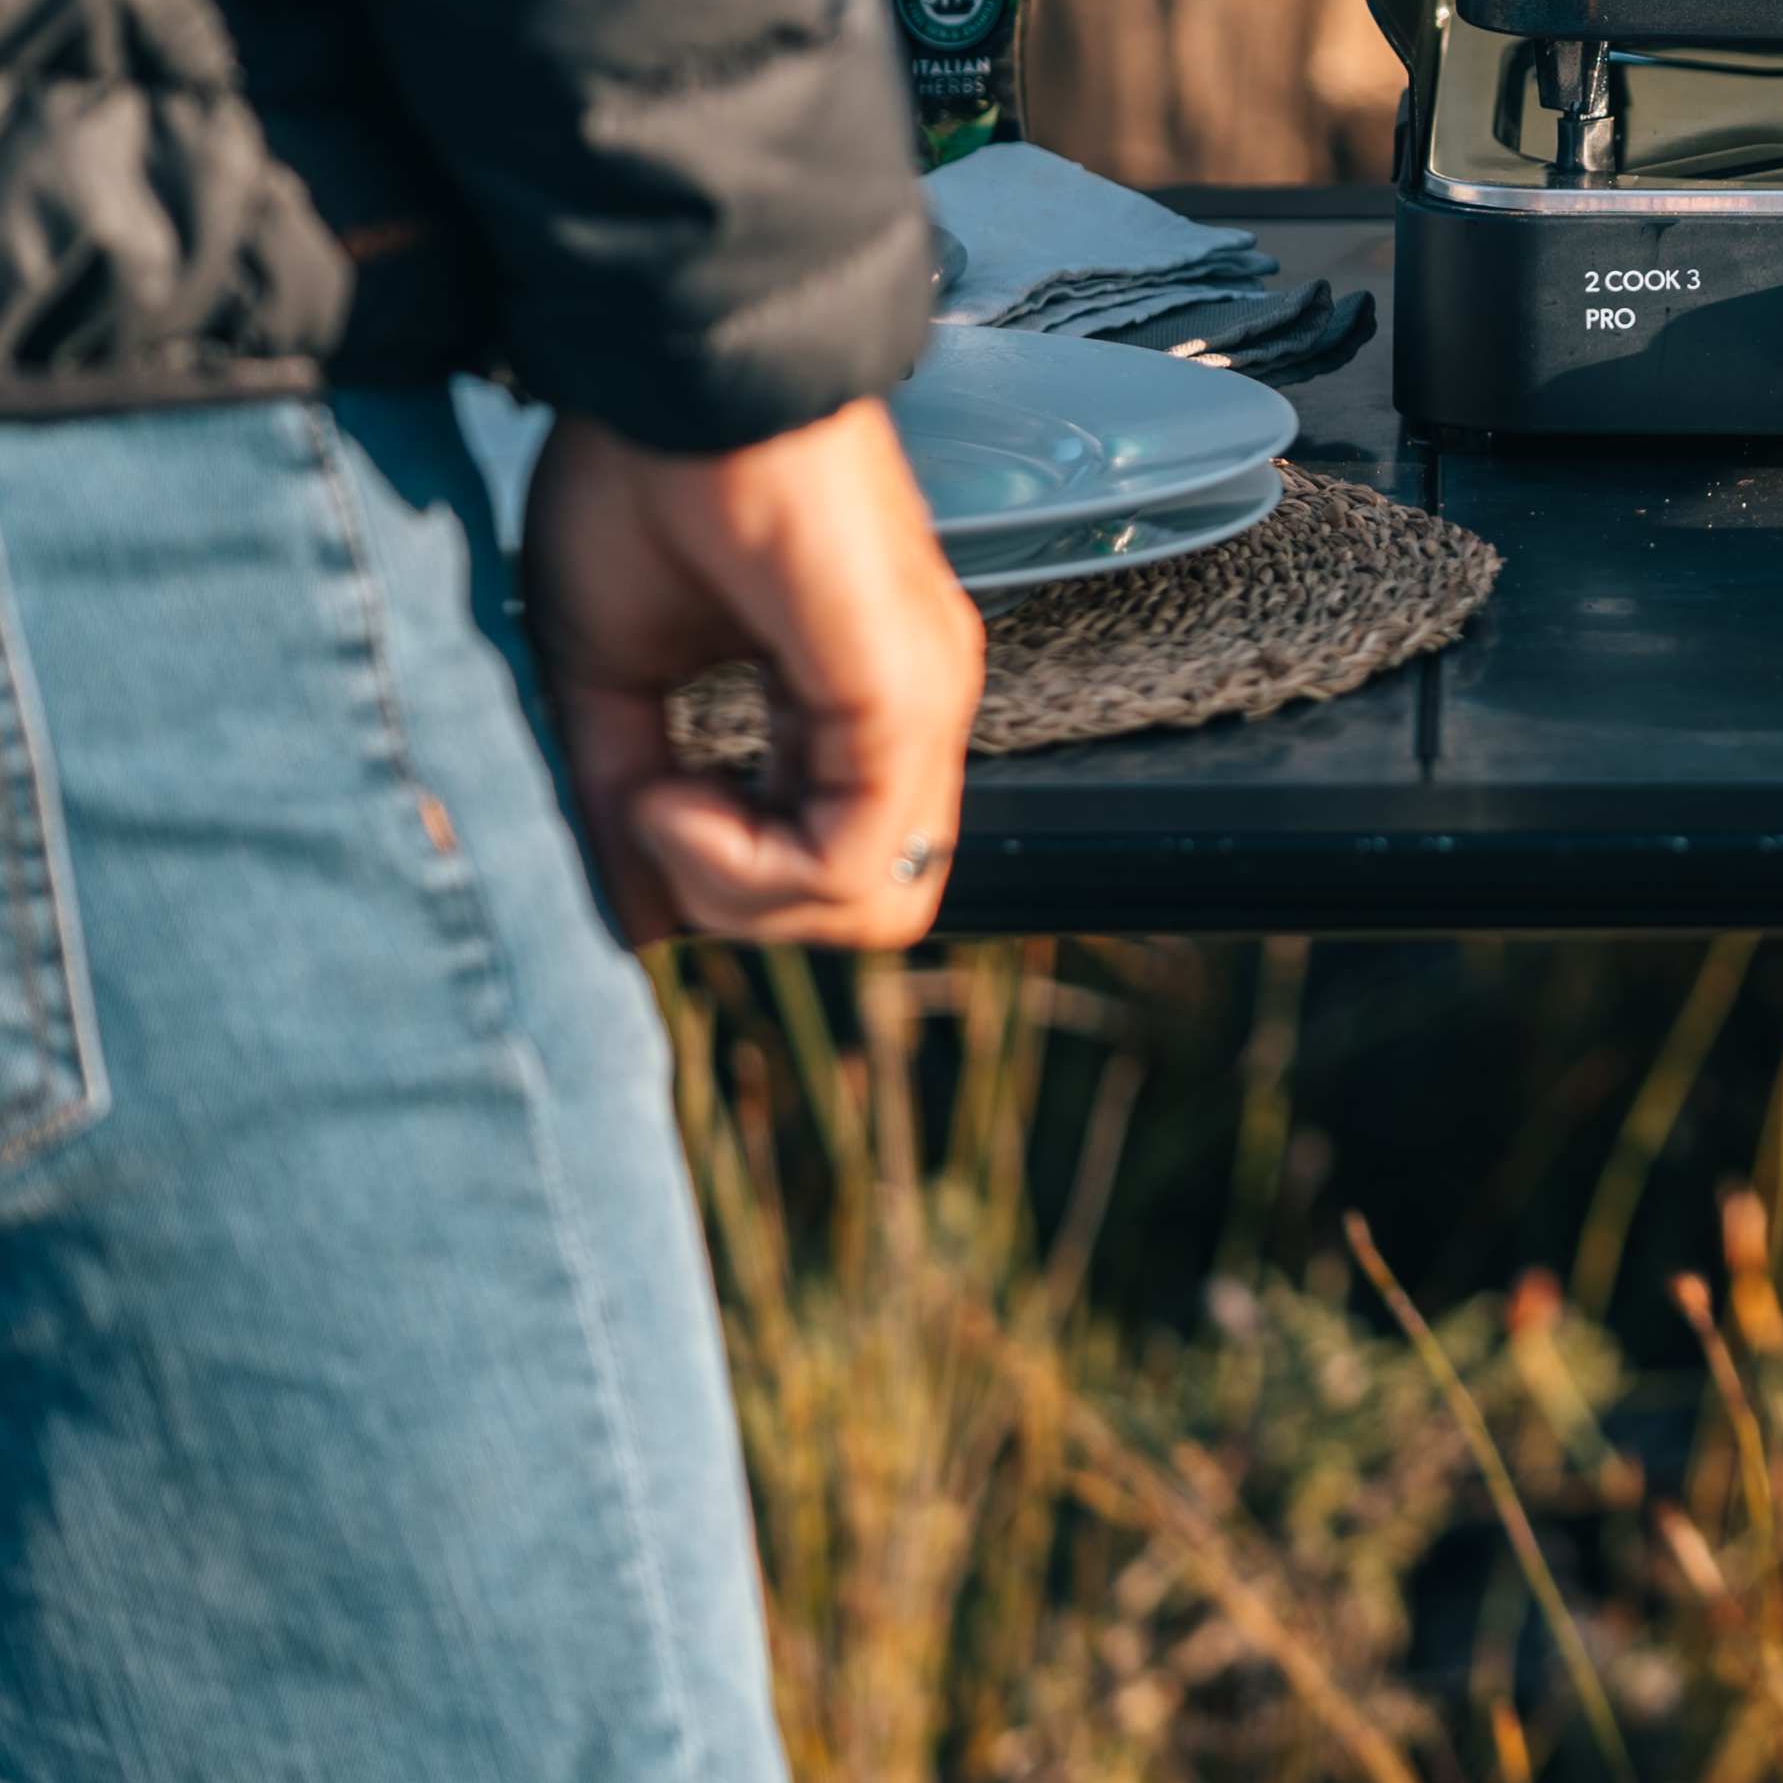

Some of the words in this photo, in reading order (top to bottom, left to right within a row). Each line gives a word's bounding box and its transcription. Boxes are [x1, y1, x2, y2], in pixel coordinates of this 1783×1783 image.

[912, 56, 991, 75] ITALIAN
[918, 76, 987, 97] HERBS
[1584, 270, 1600, 293] 2
[1604, 269, 1681, 292] COOK
[1686, 268, 1701, 290] 3
[1585, 307, 1636, 330] PRO
